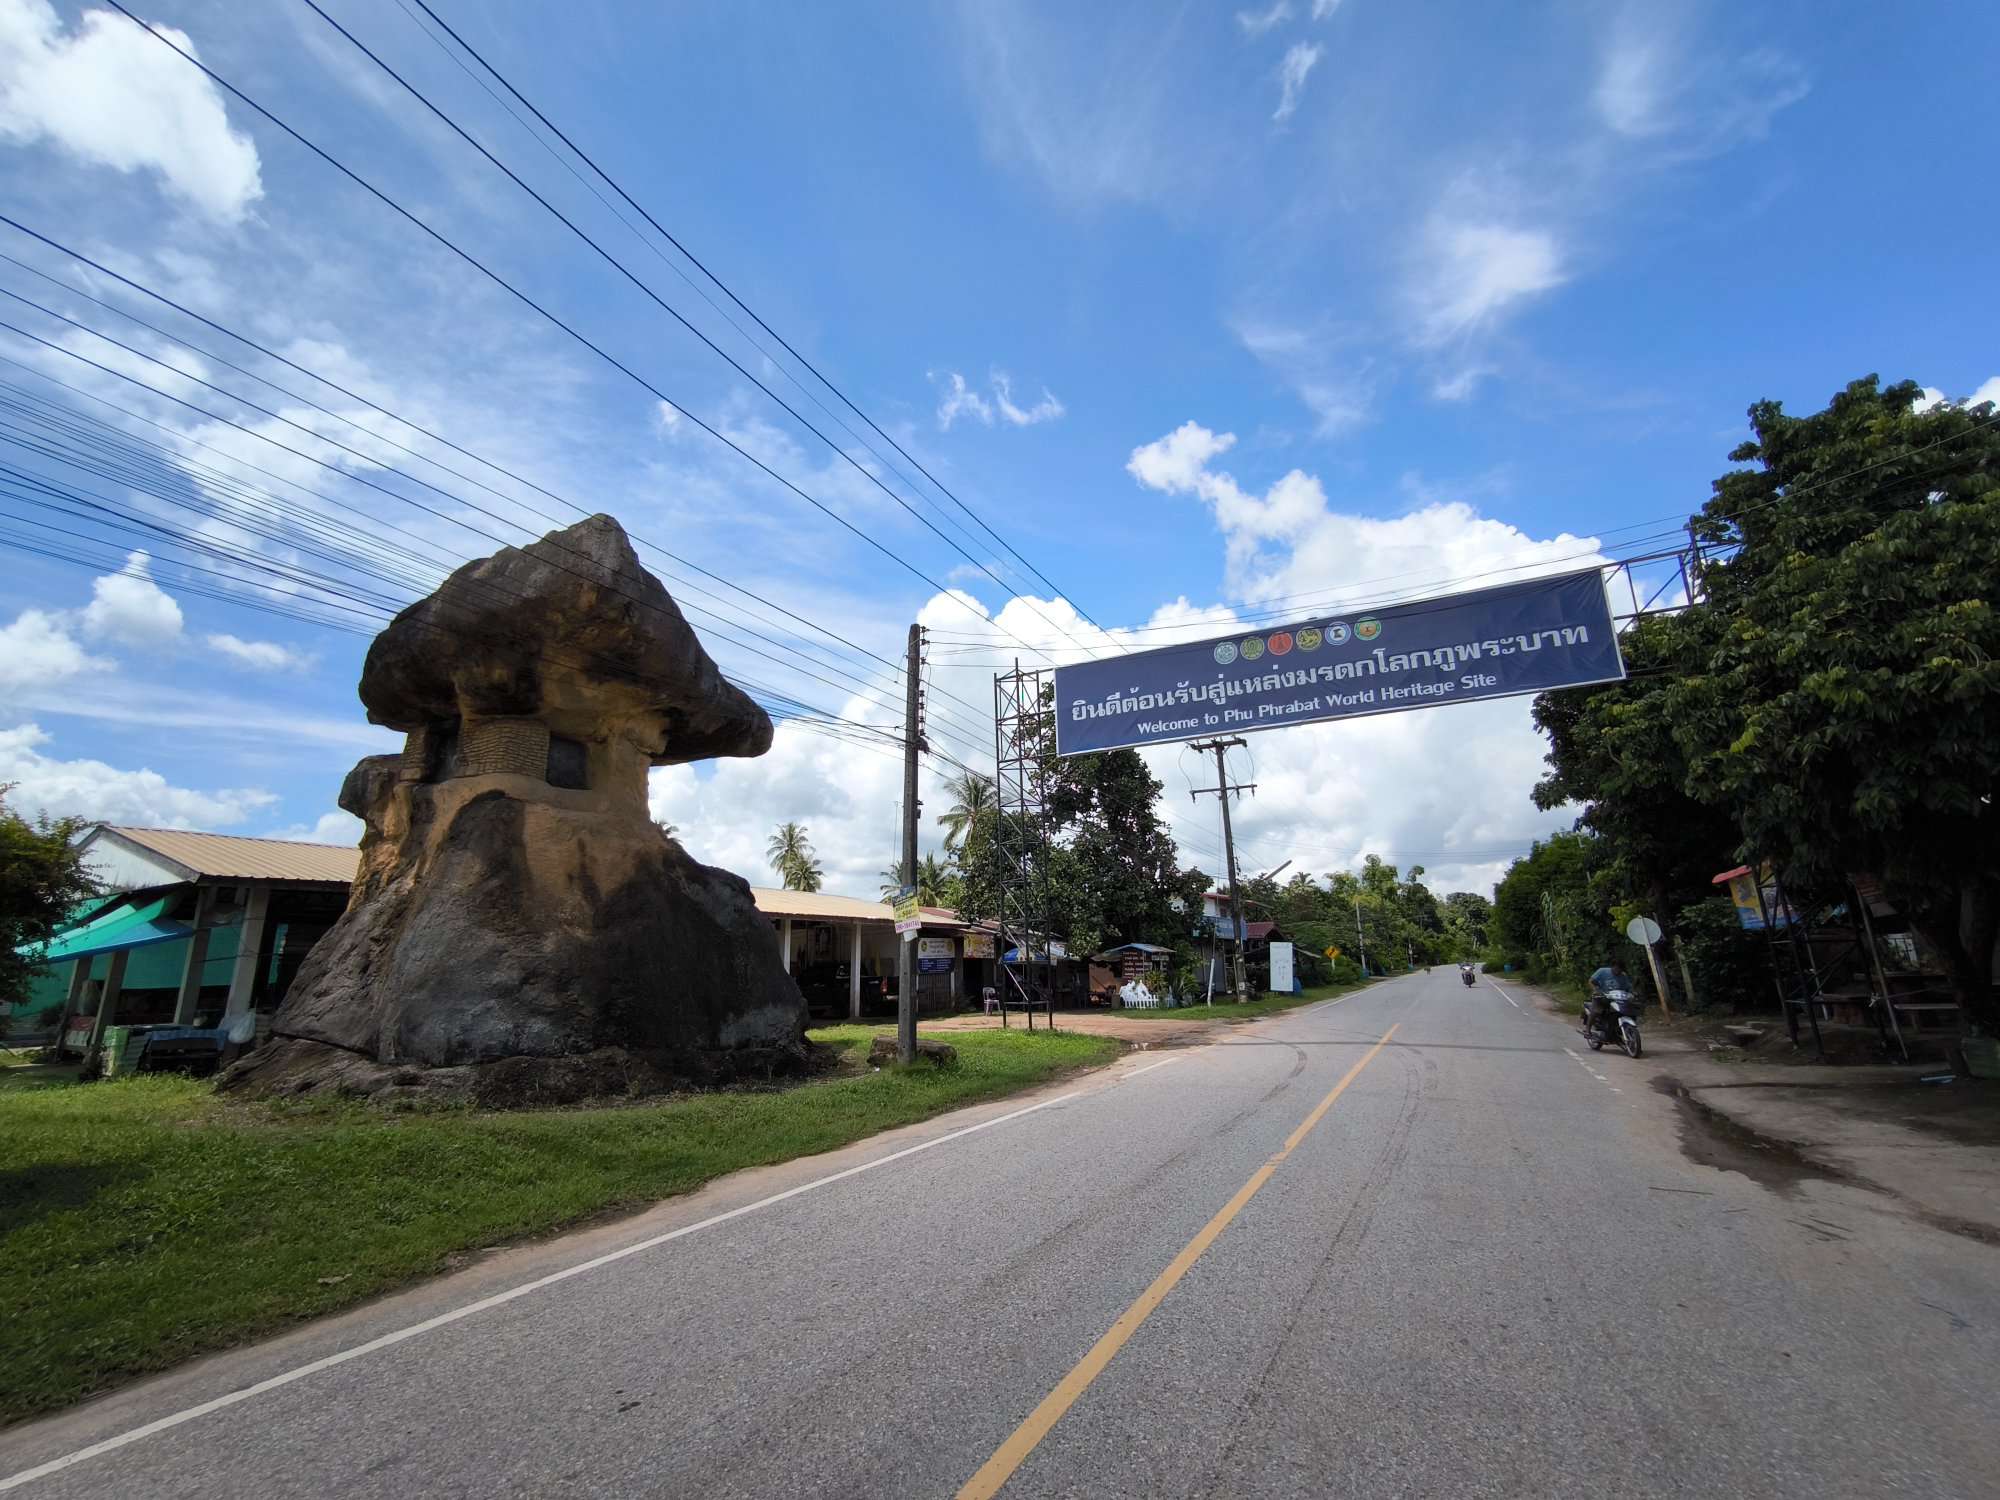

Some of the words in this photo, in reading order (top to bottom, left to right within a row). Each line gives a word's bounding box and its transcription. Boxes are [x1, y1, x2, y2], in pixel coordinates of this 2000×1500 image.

[1072, 625, 1588, 721] ยินดีต้อนรับสู่แหล่งมรดกโลกภูพระบาท
[1138, 719, 1198, 735] Welcome
[1204, 713, 1218, 725] to
[1225, 709, 1252, 723] Phu
[1258, 697, 1320, 718] Phrabat
[1326, 689, 1374, 707] World
[1381, 681, 1454, 702] Heritage
[1461, 673, 1497, 689] Site
